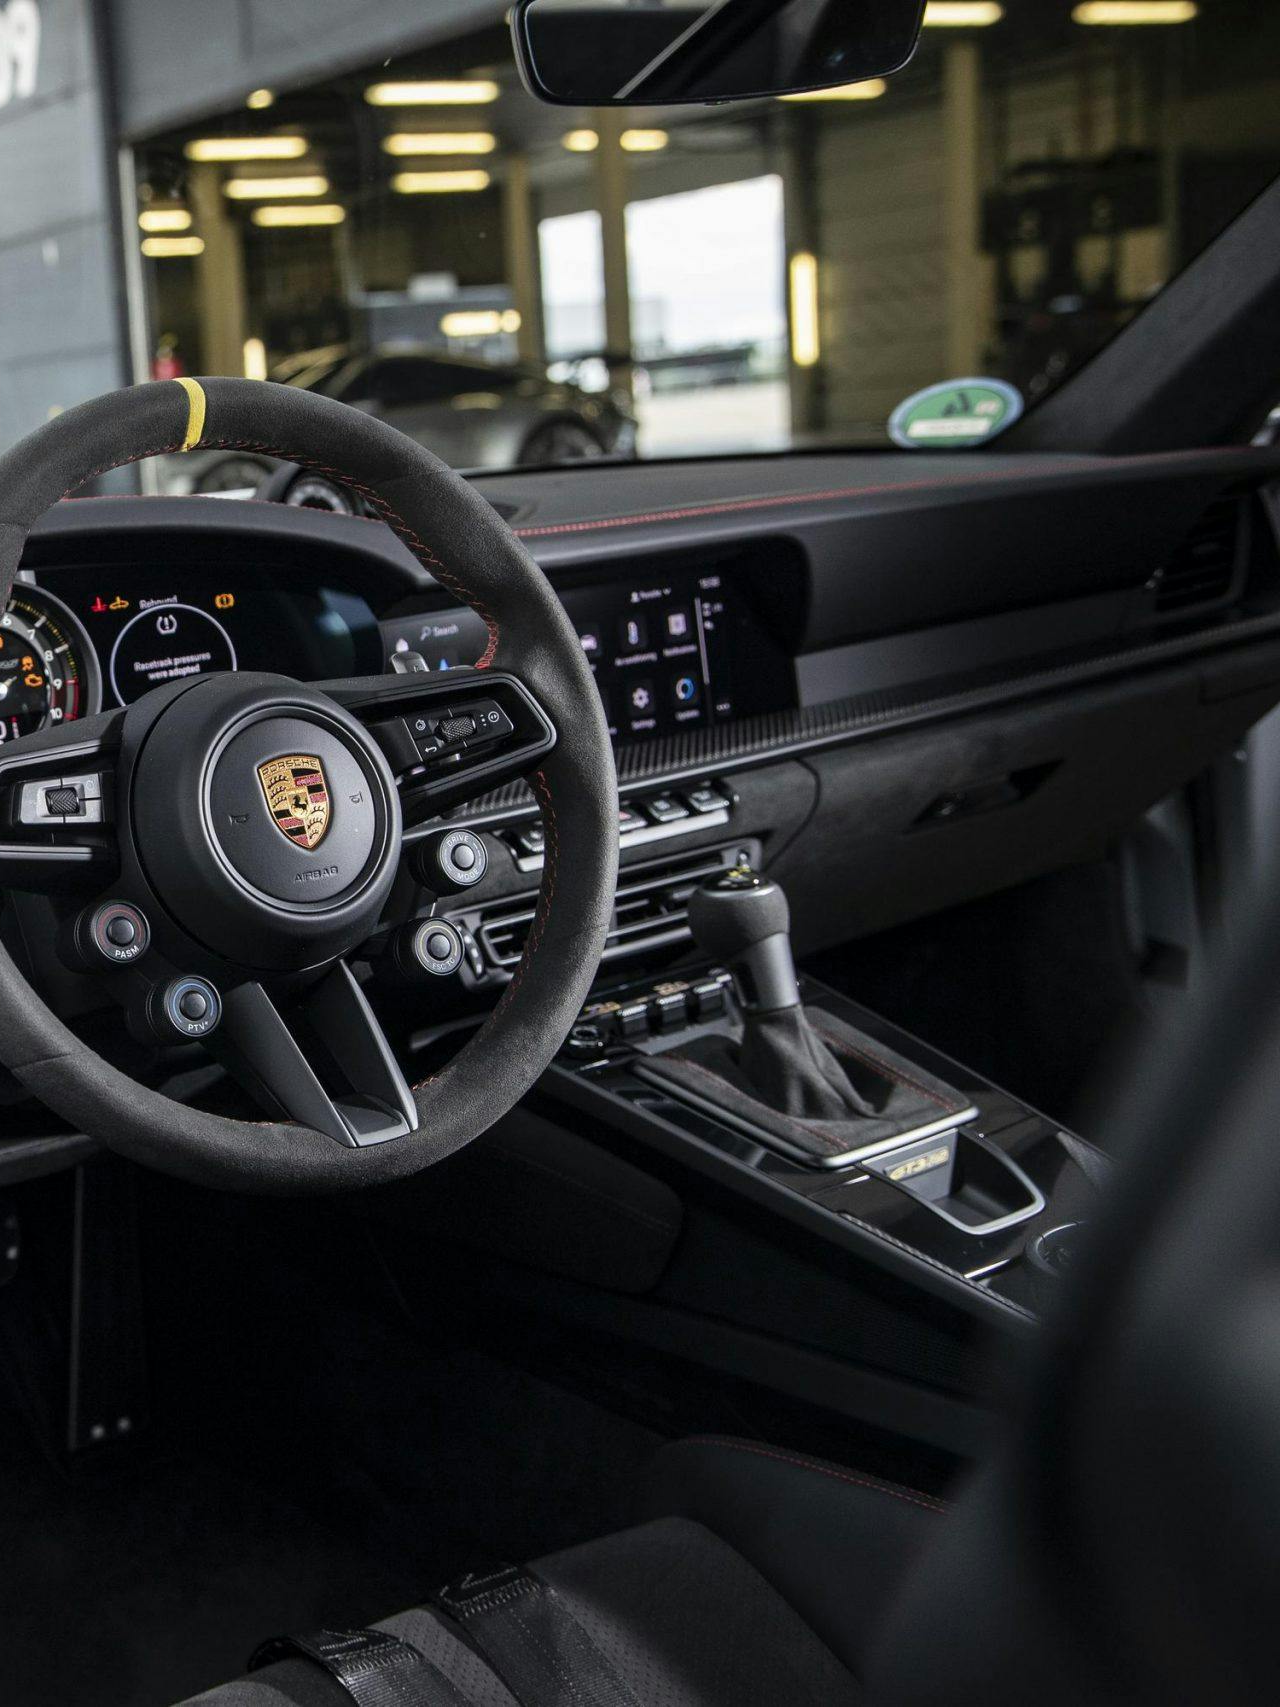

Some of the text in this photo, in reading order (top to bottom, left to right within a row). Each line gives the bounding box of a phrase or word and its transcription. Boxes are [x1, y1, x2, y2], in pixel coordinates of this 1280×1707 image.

[2, 615, 12, 627] 6
[27, 629, 36, 641] 7
[433, 624, 459, 637] Search
[44, 649, 54, 662] 8
[133, 651, 211, 672] Racetrack pressures
[148, 663, 201, 680] were adopted
[53, 678, 63, 690] 9
[50, 707, 63, 719] 10
[261, 757, 318, 777] PORSCHE
[447, 834, 469, 847] DRIVE
[294, 865, 339, 883] AIRBAG
[457, 869, 479, 880] MODE
[115, 945, 140, 959] PASM
